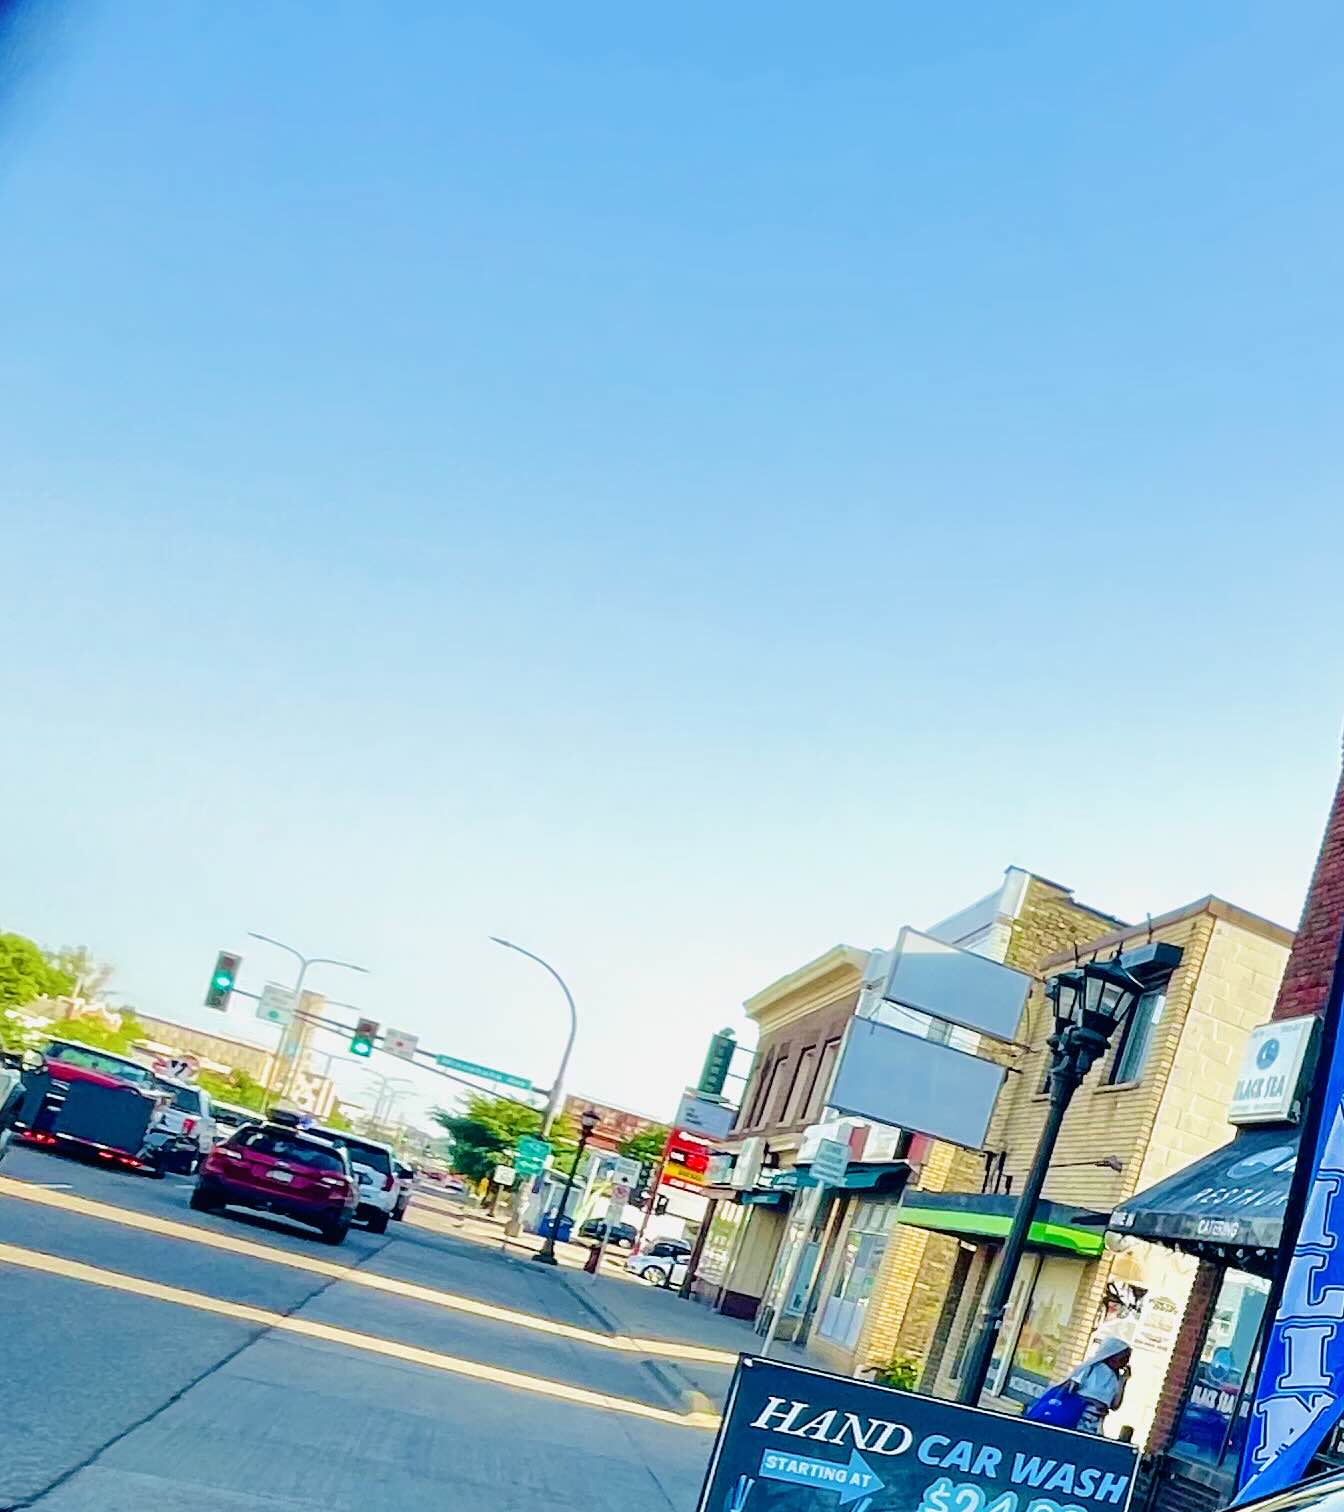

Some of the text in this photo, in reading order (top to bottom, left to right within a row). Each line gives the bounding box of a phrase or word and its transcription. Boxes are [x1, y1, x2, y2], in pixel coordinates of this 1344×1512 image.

[750, 1396, 1130, 1504] HAND CAR WASH
[764, 1455, 875, 1489] STARTING AT
